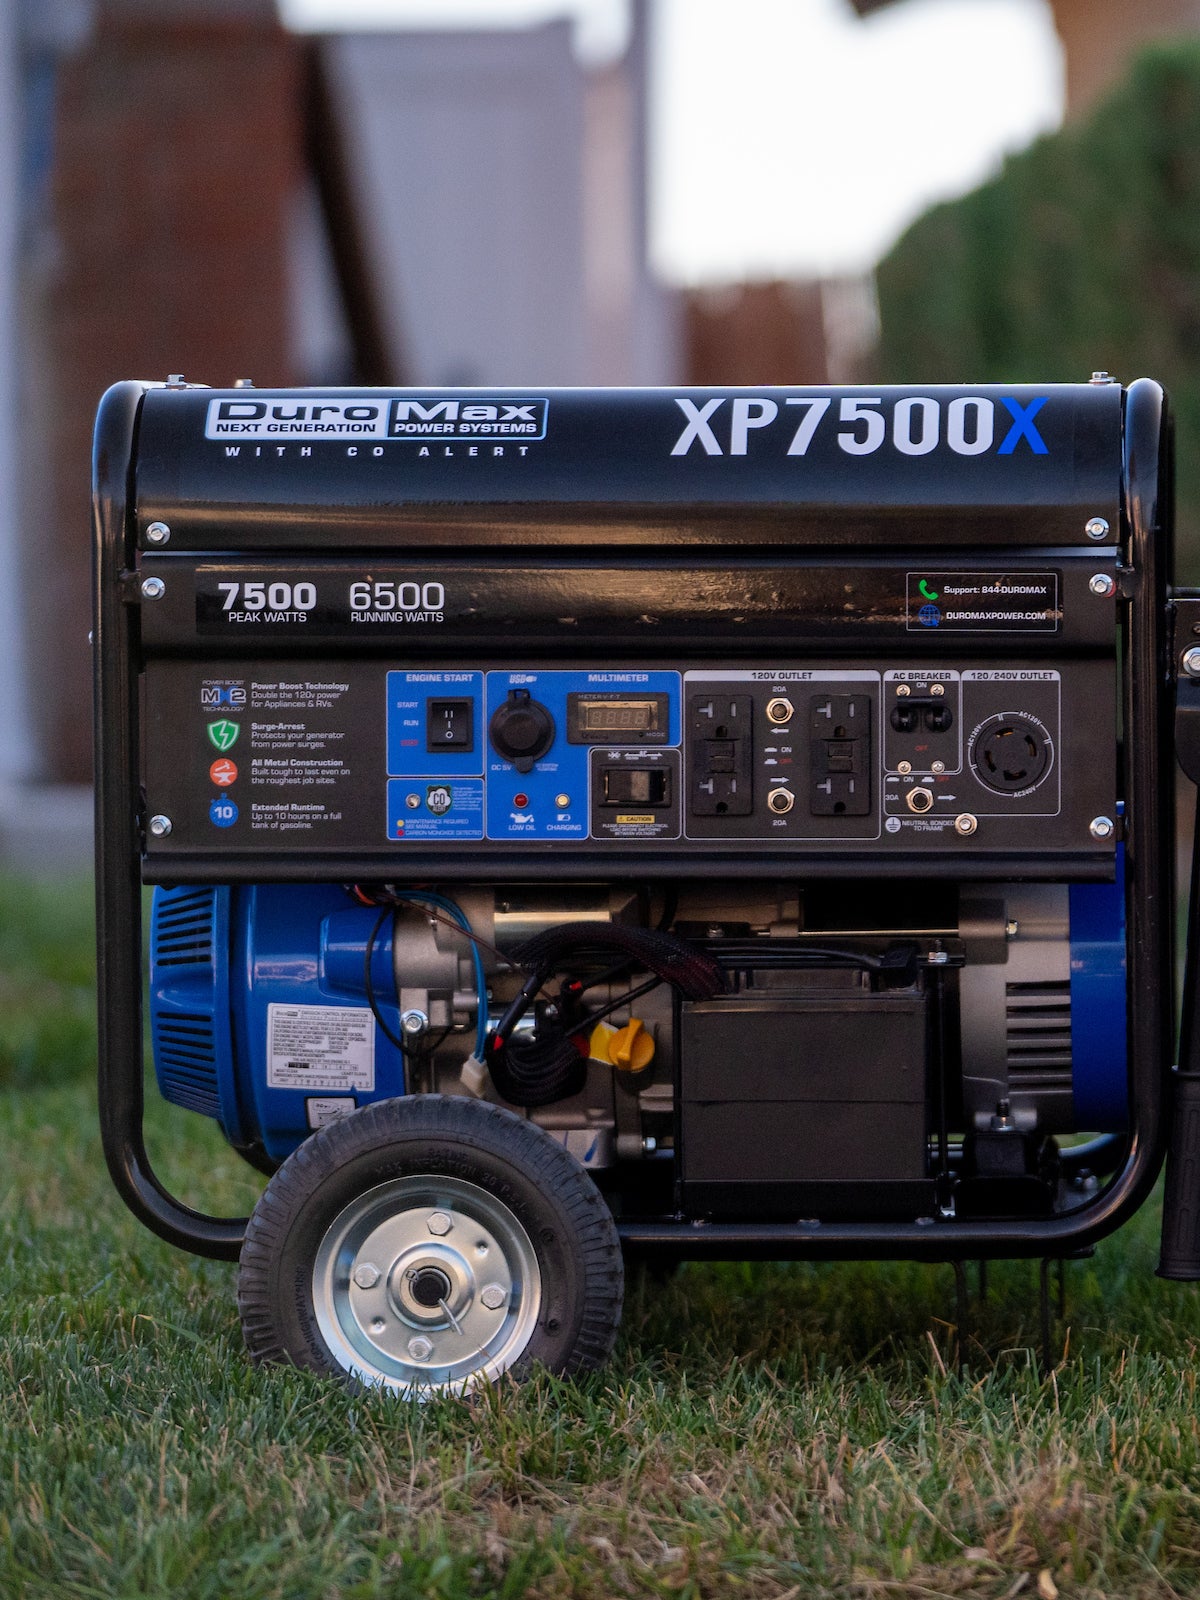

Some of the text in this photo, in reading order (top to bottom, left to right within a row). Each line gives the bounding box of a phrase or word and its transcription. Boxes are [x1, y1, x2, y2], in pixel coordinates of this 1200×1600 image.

[217, 401, 537, 420] Duro Max
[216, 424, 376, 433] NEXT GENERATION
[394, 424, 537, 433] POWER SYSTEMS
[669, 396, 1051, 456] XP7500X
[225, 447, 529, 457] WITH CO ALERT
[943, 585, 1047, 595] Support: 844-DUROMAX
[217, 583, 317, 610] 7500
[349, 582, 445, 610] 6500
[228, 612, 307, 623] PEAK WATTS
[351, 612, 444, 623] RUNNING WATTS
[946, 612, 1046, 620] DUROMAXPOWER.COM
[405, 674, 473, 682] ENGINE START
[588, 674, 649, 682] MULTIMETER
[751, 672, 813, 680] 120V OUTLET
[892, 672, 952, 680] AC BREAKER
[970, 672, 1053, 680] 120/240V OUTLET
[251, 682, 349, 691] Power Boost Technology
[772, 685, 787, 693] 20A
[251, 700, 263, 708] for
[264, 700, 306, 709] Appliances
[307, 700, 315, 708] &
[1018, 711, 1042, 726] AC120V
[251, 722, 306, 731] Surge-Arrest
[306, 732, 345, 740] generator
[967, 724, 983, 747] AC120V
[251, 759, 344, 767] All Metal Construction
[270, 768, 294, 776] tough
[266, 777, 301, 785] roughest
[302, 777, 315, 785] job
[1013, 787, 1037, 798] AC240V
[433, 793, 446, 805] CO
[251, 803, 325, 811] Extended Runtime
[213, 806, 233, 819] 10
[251, 813, 263, 821] Up
[275, 812, 286, 820] 10
[329, 812, 342, 820] full
[279, 822, 313, 830] gasoline.
